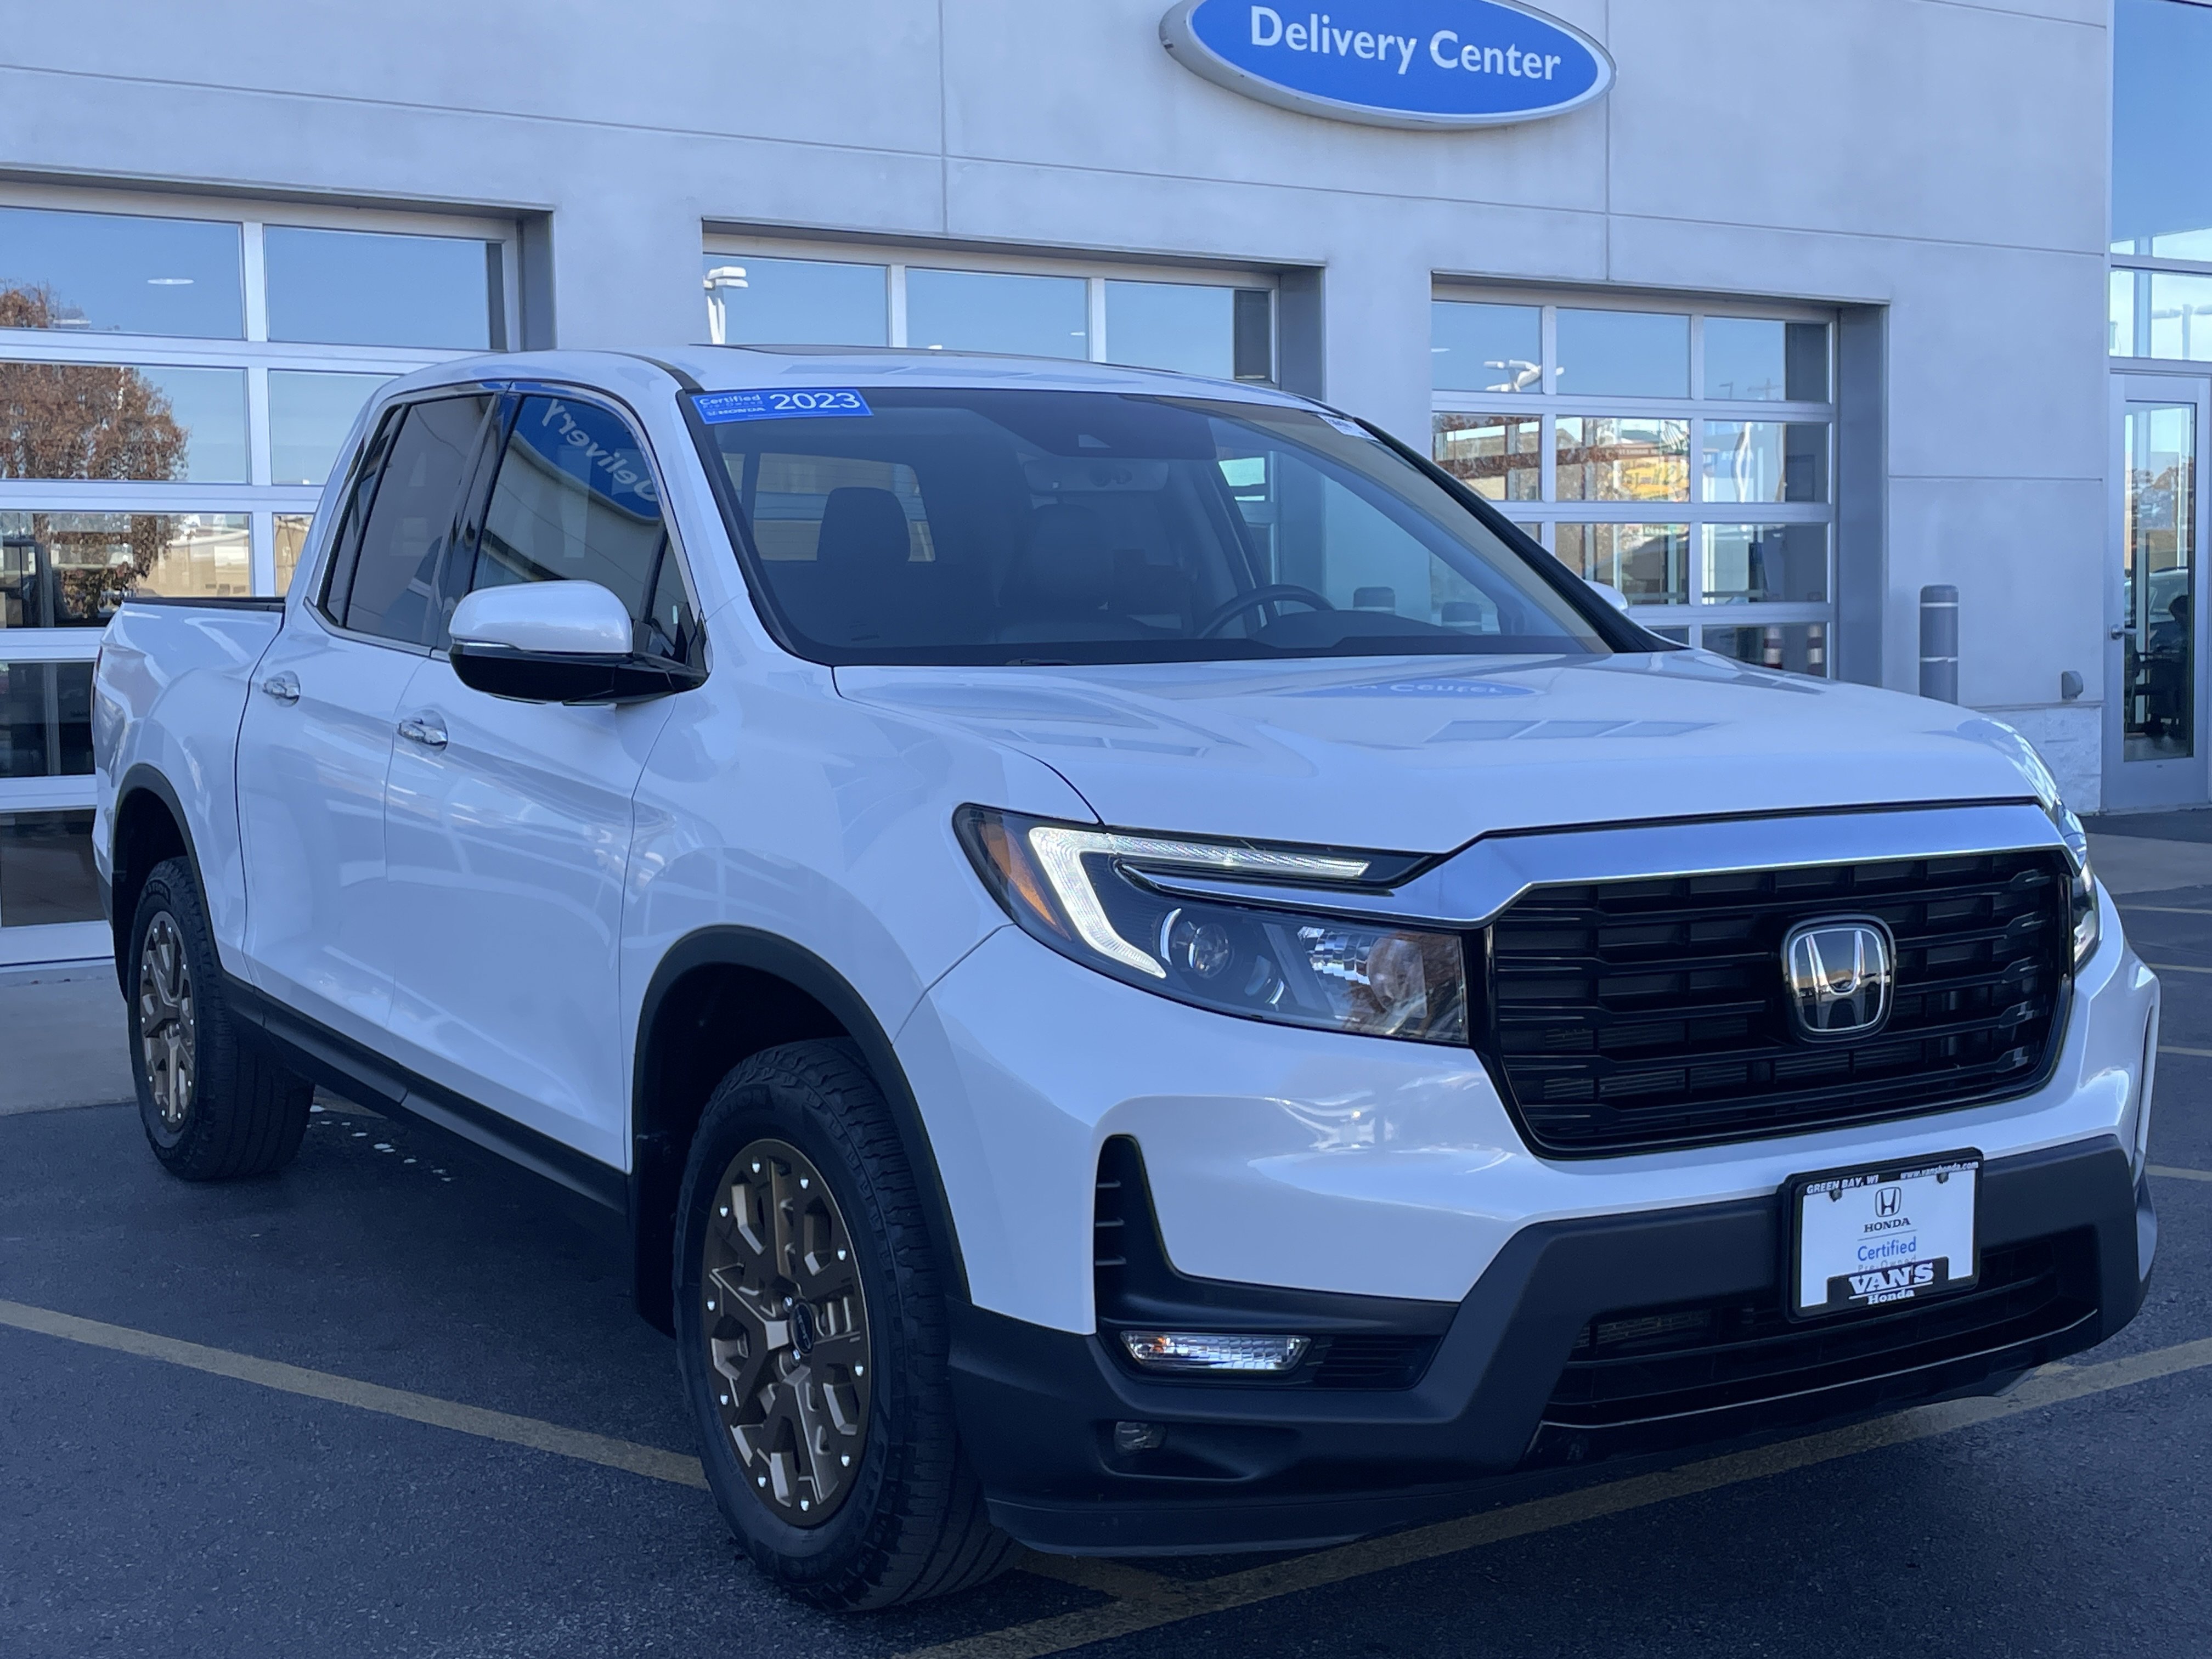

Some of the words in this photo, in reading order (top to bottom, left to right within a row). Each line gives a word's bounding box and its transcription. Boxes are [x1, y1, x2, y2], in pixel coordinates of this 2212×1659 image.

[1251, 5, 1418, 75] Delivery
[1429, 30, 1561, 81] Center
[699, 394, 761, 405] Certified
[769, 392, 861, 410] 2023
[1806, 1180, 1840, 1195] GREEN
[1866, 1174, 1880, 1186] WI
[1863, 1217, 1911, 1233] HONDA
[1857, 1235, 1917, 1261] Certified
[1867, 1289, 1915, 1305] Honda
